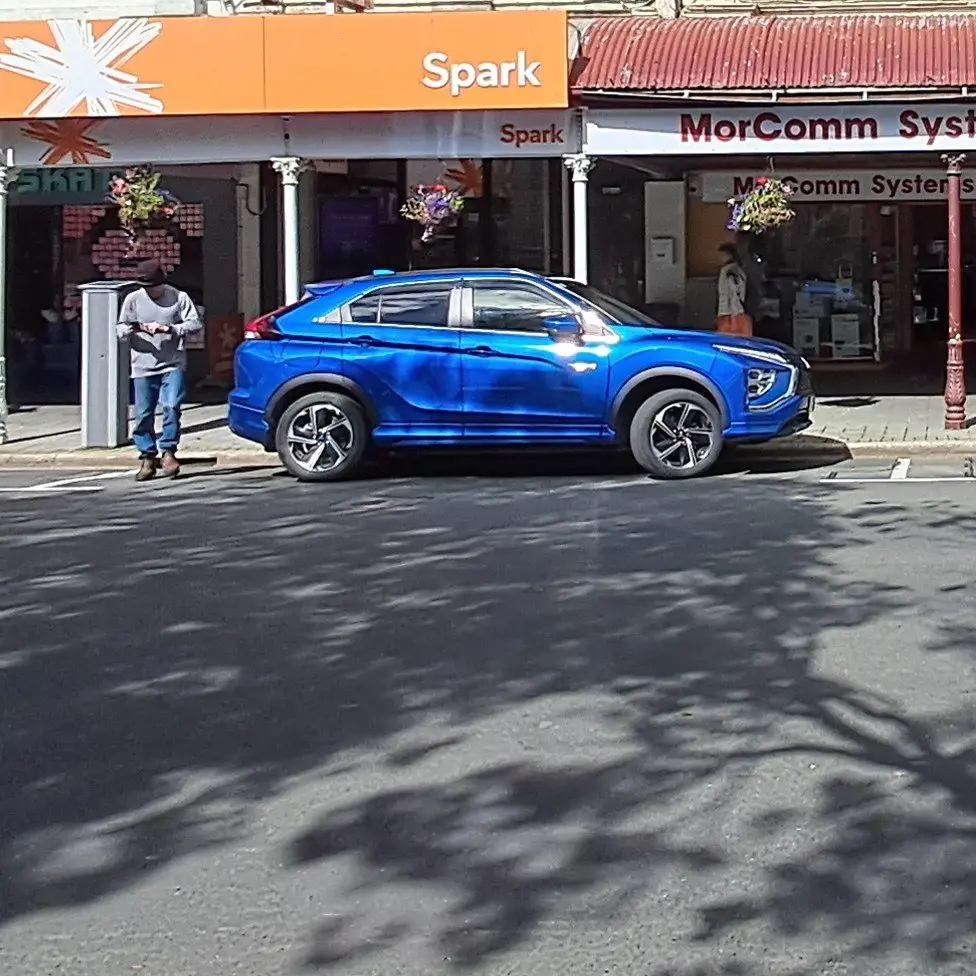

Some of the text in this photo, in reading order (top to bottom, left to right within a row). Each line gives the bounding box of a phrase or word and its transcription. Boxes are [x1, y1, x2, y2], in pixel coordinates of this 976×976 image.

[422, 51, 542, 97] Spark
[500, 124, 564, 148] Spark
[680, 112, 878, 142] MorComm
